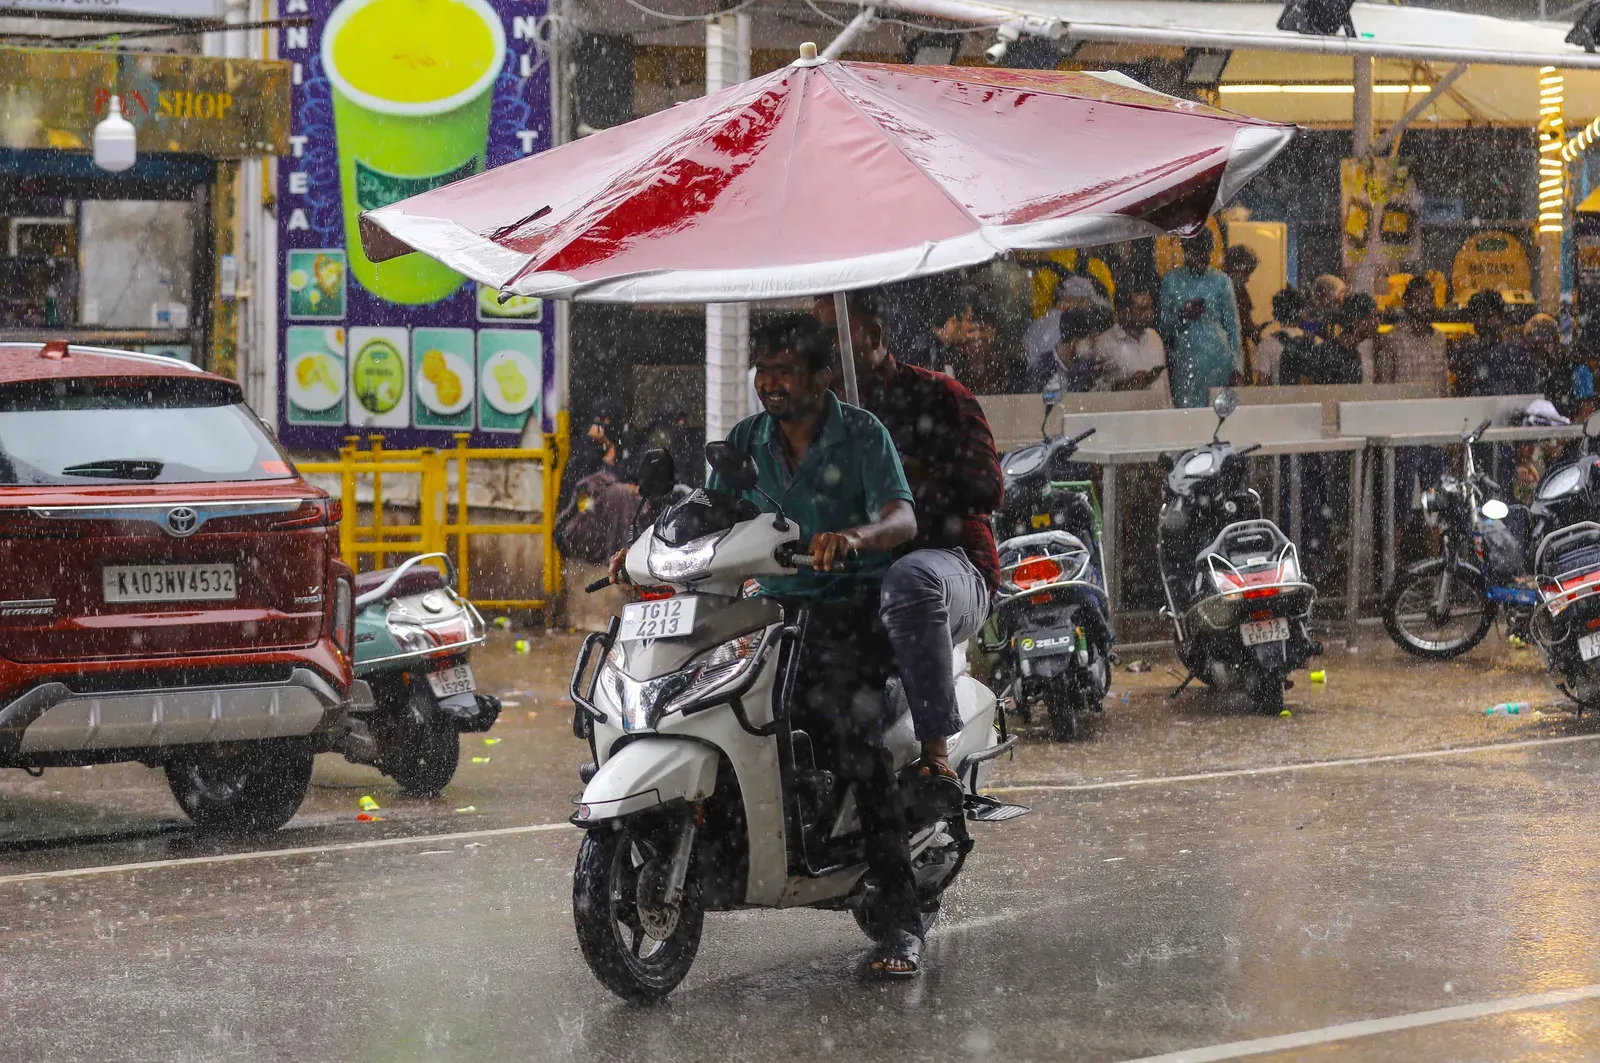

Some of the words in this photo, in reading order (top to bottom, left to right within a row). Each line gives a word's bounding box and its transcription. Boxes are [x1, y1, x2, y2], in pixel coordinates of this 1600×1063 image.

[157, 91, 233, 120] SHOP
[289, 136, 309, 231] TEA
[641, 600, 682, 620] TG12
[636, 618, 680, 637] 4213
[1035, 635, 1071, 648] ZELIO
